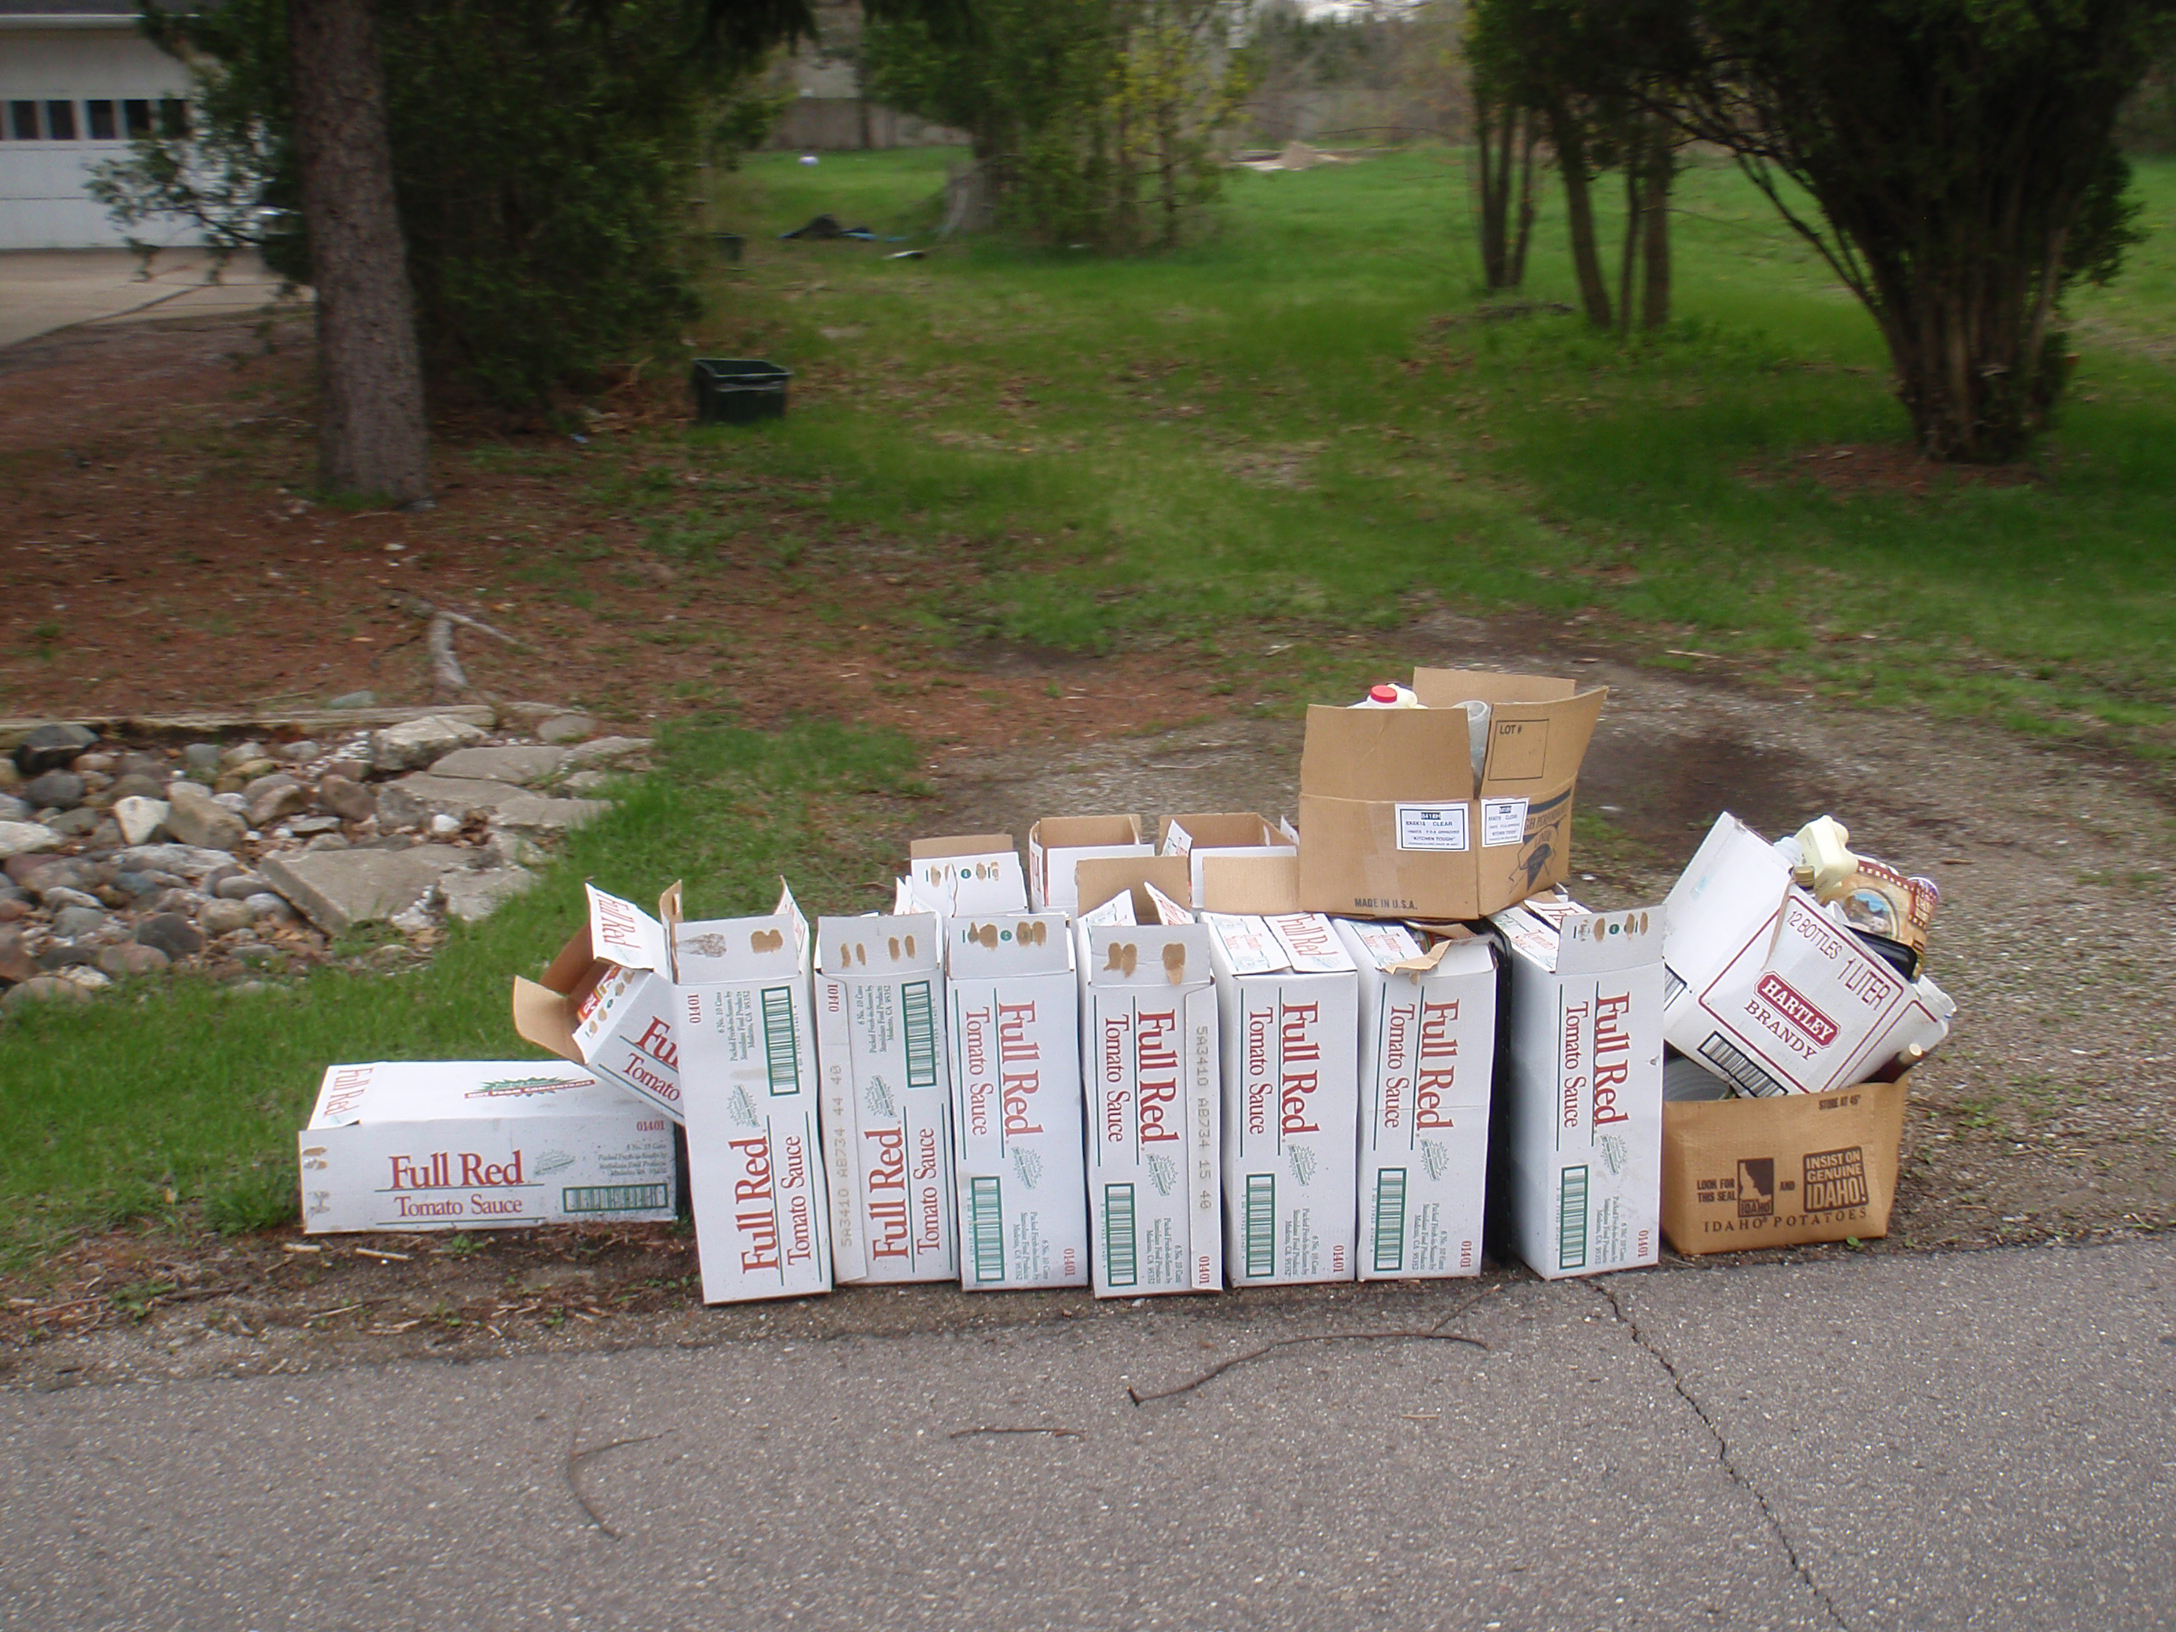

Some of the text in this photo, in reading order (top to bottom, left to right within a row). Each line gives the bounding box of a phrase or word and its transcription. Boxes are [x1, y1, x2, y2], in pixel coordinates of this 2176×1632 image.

[1500, 724, 1516, 734] LOT
[1354, 898, 1418, 910] MADE IN U.S.A.
[1277, 913, 1338, 956] Full Red
[1787, 910, 1892, 1011] 12 BOTTLES 1 LITER
[687, 994, 702, 1024] 01401
[828, 984, 840, 1012] 01401
[1596, 991, 1630, 1054] Full
[1761, 978, 1834, 1041] HARTLEY
[634, 1016, 678, 1069] Fu
[998, 1000, 1042, 1066] Full
[1138, 1008, 1178, 1072] Full
[1282, 1000, 1320, 1065] Full
[1422, 998, 1460, 1060] Full
[1744, 999, 1818, 1061] BRANDY
[622, 1052, 680, 1101] Tomato
[830, 1064, 842, 1085] 40
[966, 1006, 994, 1136] Tomato Sauce
[1104, 1014, 1130, 1144] Tomato Sauce
[1248, 1006, 1274, 1136] Tomato Sauce
[1383, 1003, 1416, 1130] Tomato Sauce
[1564, 1000, 1589, 1128] Tomato Sauce
[832, 1096, 844, 1116] 44
[1003, 1070, 1044, 1138] Red
[1139, 1078, 1180, 1146] Red
[1282, 1070, 1320, 1136] Red
[1416, 1065, 1456, 1132] Red
[1592, 1058, 1630, 1126] Red
[636, 1120, 666, 1132] 01401
[1198, 1098, 1210, 1148] AB734
[388, 1151, 452, 1190] Full
[458, 1149, 525, 1187] Red
[728, 1136, 774, 1205] Red
[834, 1128, 848, 1178] AB734
[864, 1124, 906, 1196] Red
[1199, 1160, 1211, 1180] 15
[1806, 1150, 1860, 1170] INSIST ON
[1806, 1163, 1862, 1182] GENUINE
[394, 1193, 524, 1218] Tomato Sauce
[780, 1135, 812, 1266] Tomato Sauce
[912, 1127, 940, 1255] Tomato Sauce
[1200, 1190, 1212, 1210] 40
[1697, 1178, 1736, 1190] LOOK FOR
[1698, 1190, 1736, 1202] THIS SEAL
[1740, 1201, 1770, 1214] IDAHO
[1780, 1181, 1796, 1192] AND
[1806, 1176, 1867, 1211] IDAHO!
[737, 1208, 779, 1275] Full
[868, 1199, 909, 1261] Full
[1774, 1207, 1867, 1228] POTATOES
[1064, 1248, 1076, 1277] 01401
[1333, 1245, 1344, 1272] 01401
[1460, 1240, 1472, 1268] 01401
[1638, 1230, 1649, 1258] 01401
[1199, 1256, 1210, 1284] 01401
